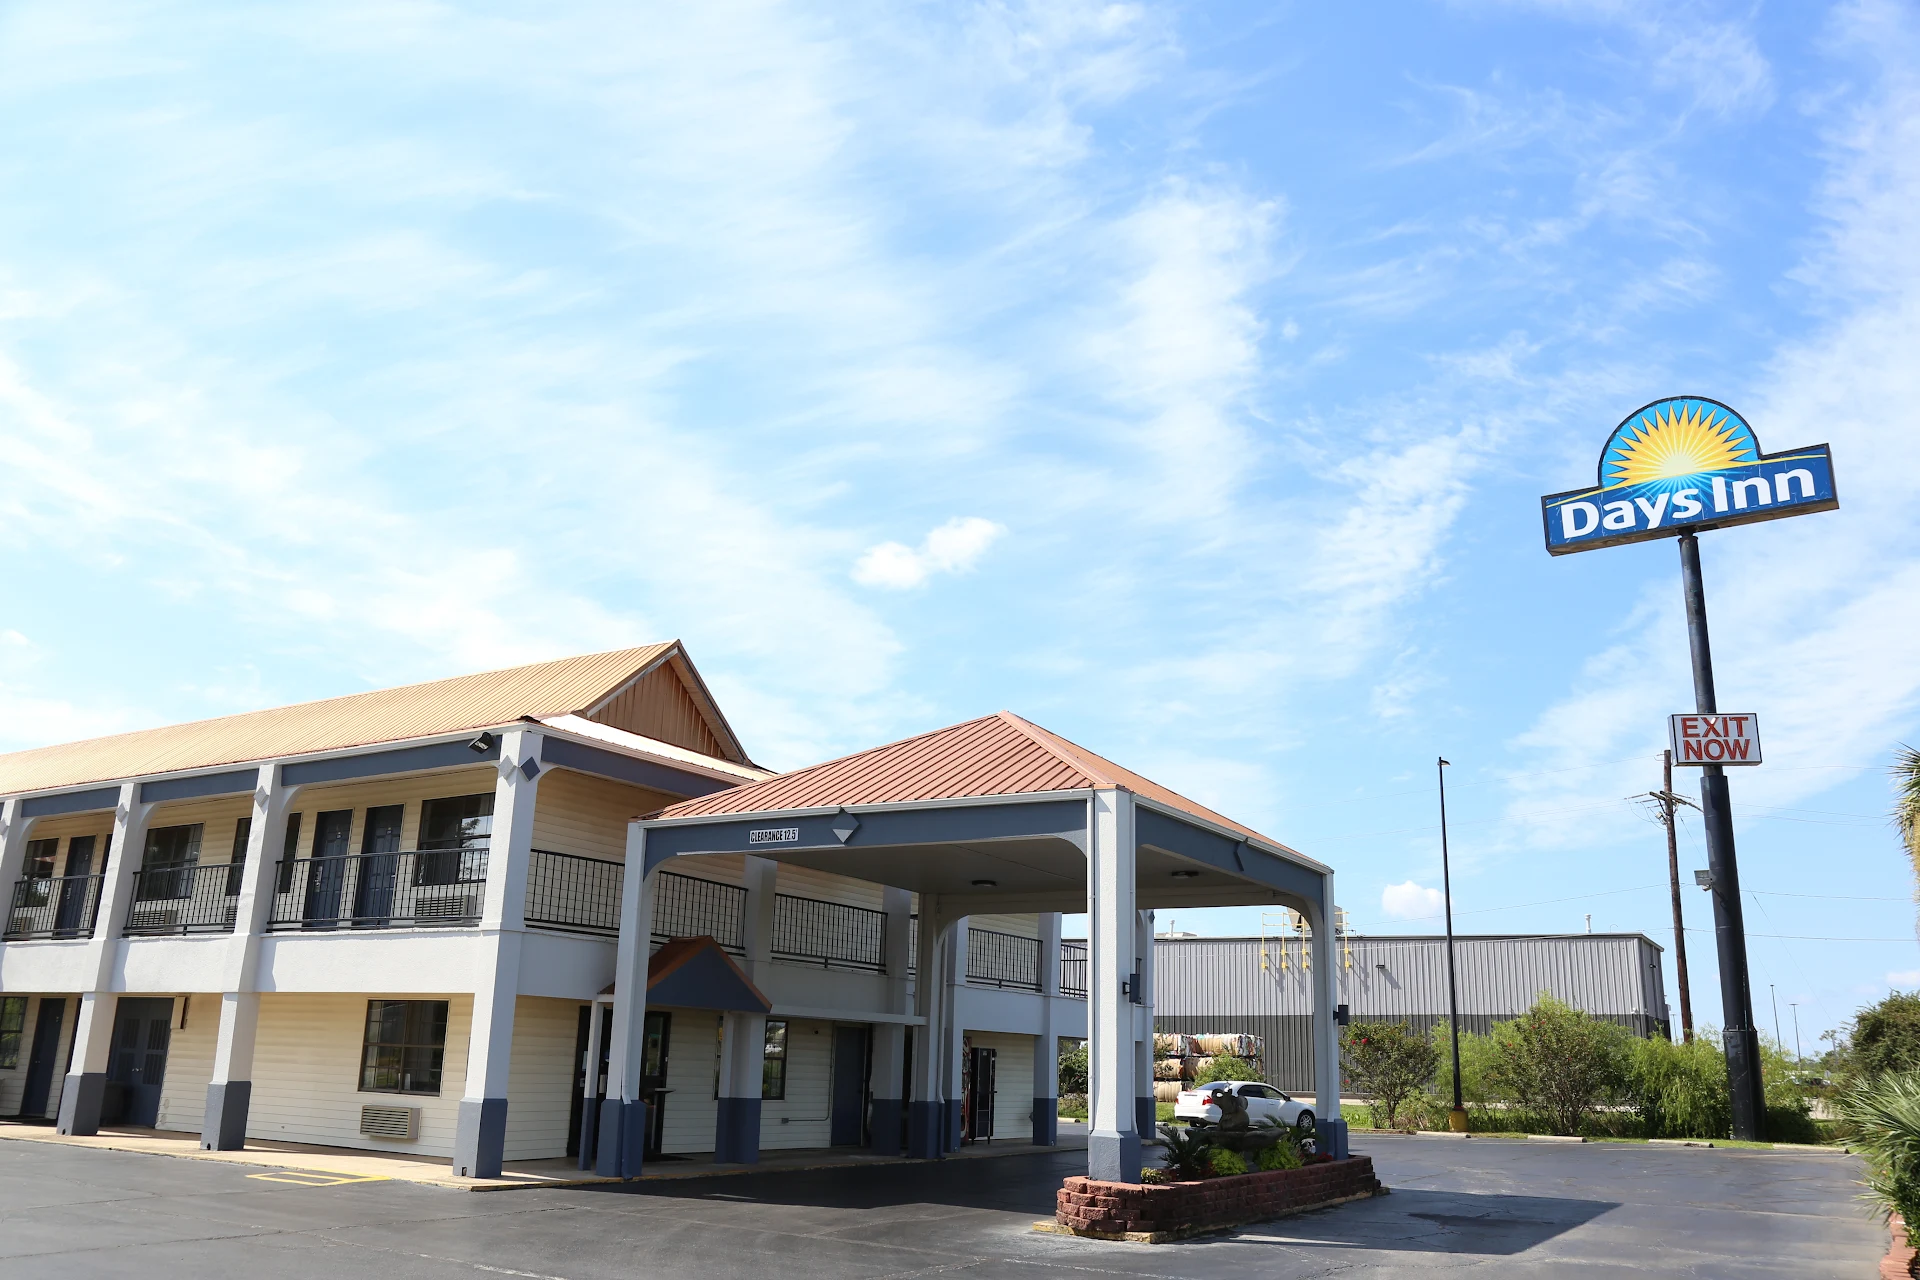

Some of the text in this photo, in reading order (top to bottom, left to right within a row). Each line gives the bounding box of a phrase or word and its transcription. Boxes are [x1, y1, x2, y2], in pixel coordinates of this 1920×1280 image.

[1560, 468, 1816, 539] Days Inn
[1681, 716, 1749, 738] EXIT
[1683, 738, 1751, 761] NOW
[750, 830, 783, 843] CLEARANCE
